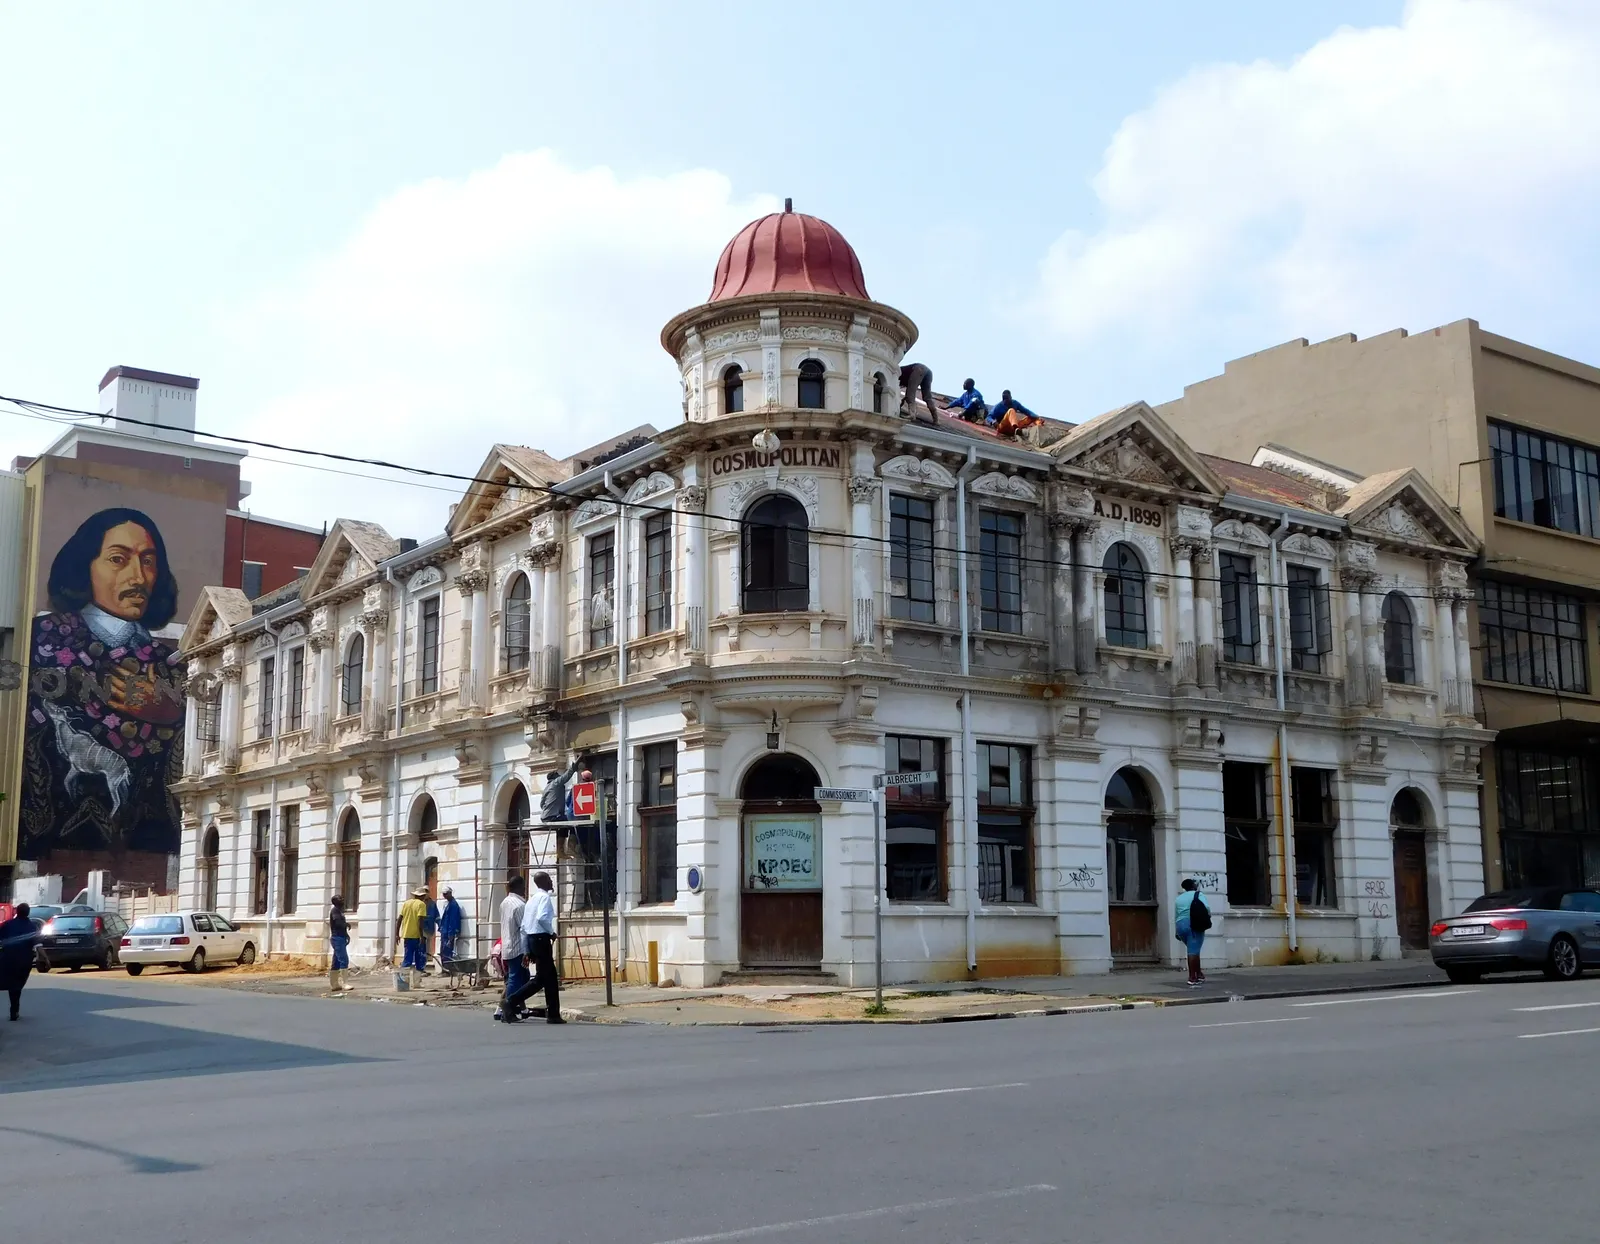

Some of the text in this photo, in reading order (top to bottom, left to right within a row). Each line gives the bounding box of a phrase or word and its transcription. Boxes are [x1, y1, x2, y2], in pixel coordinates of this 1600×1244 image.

[713, 447, 840, 475] COSMOPOLITAN
[887, 773, 922, 785] ALBRECHT
[819, 789, 857, 800] COMMISSIONER
[755, 828, 811, 843] COSMOPOLITAN
